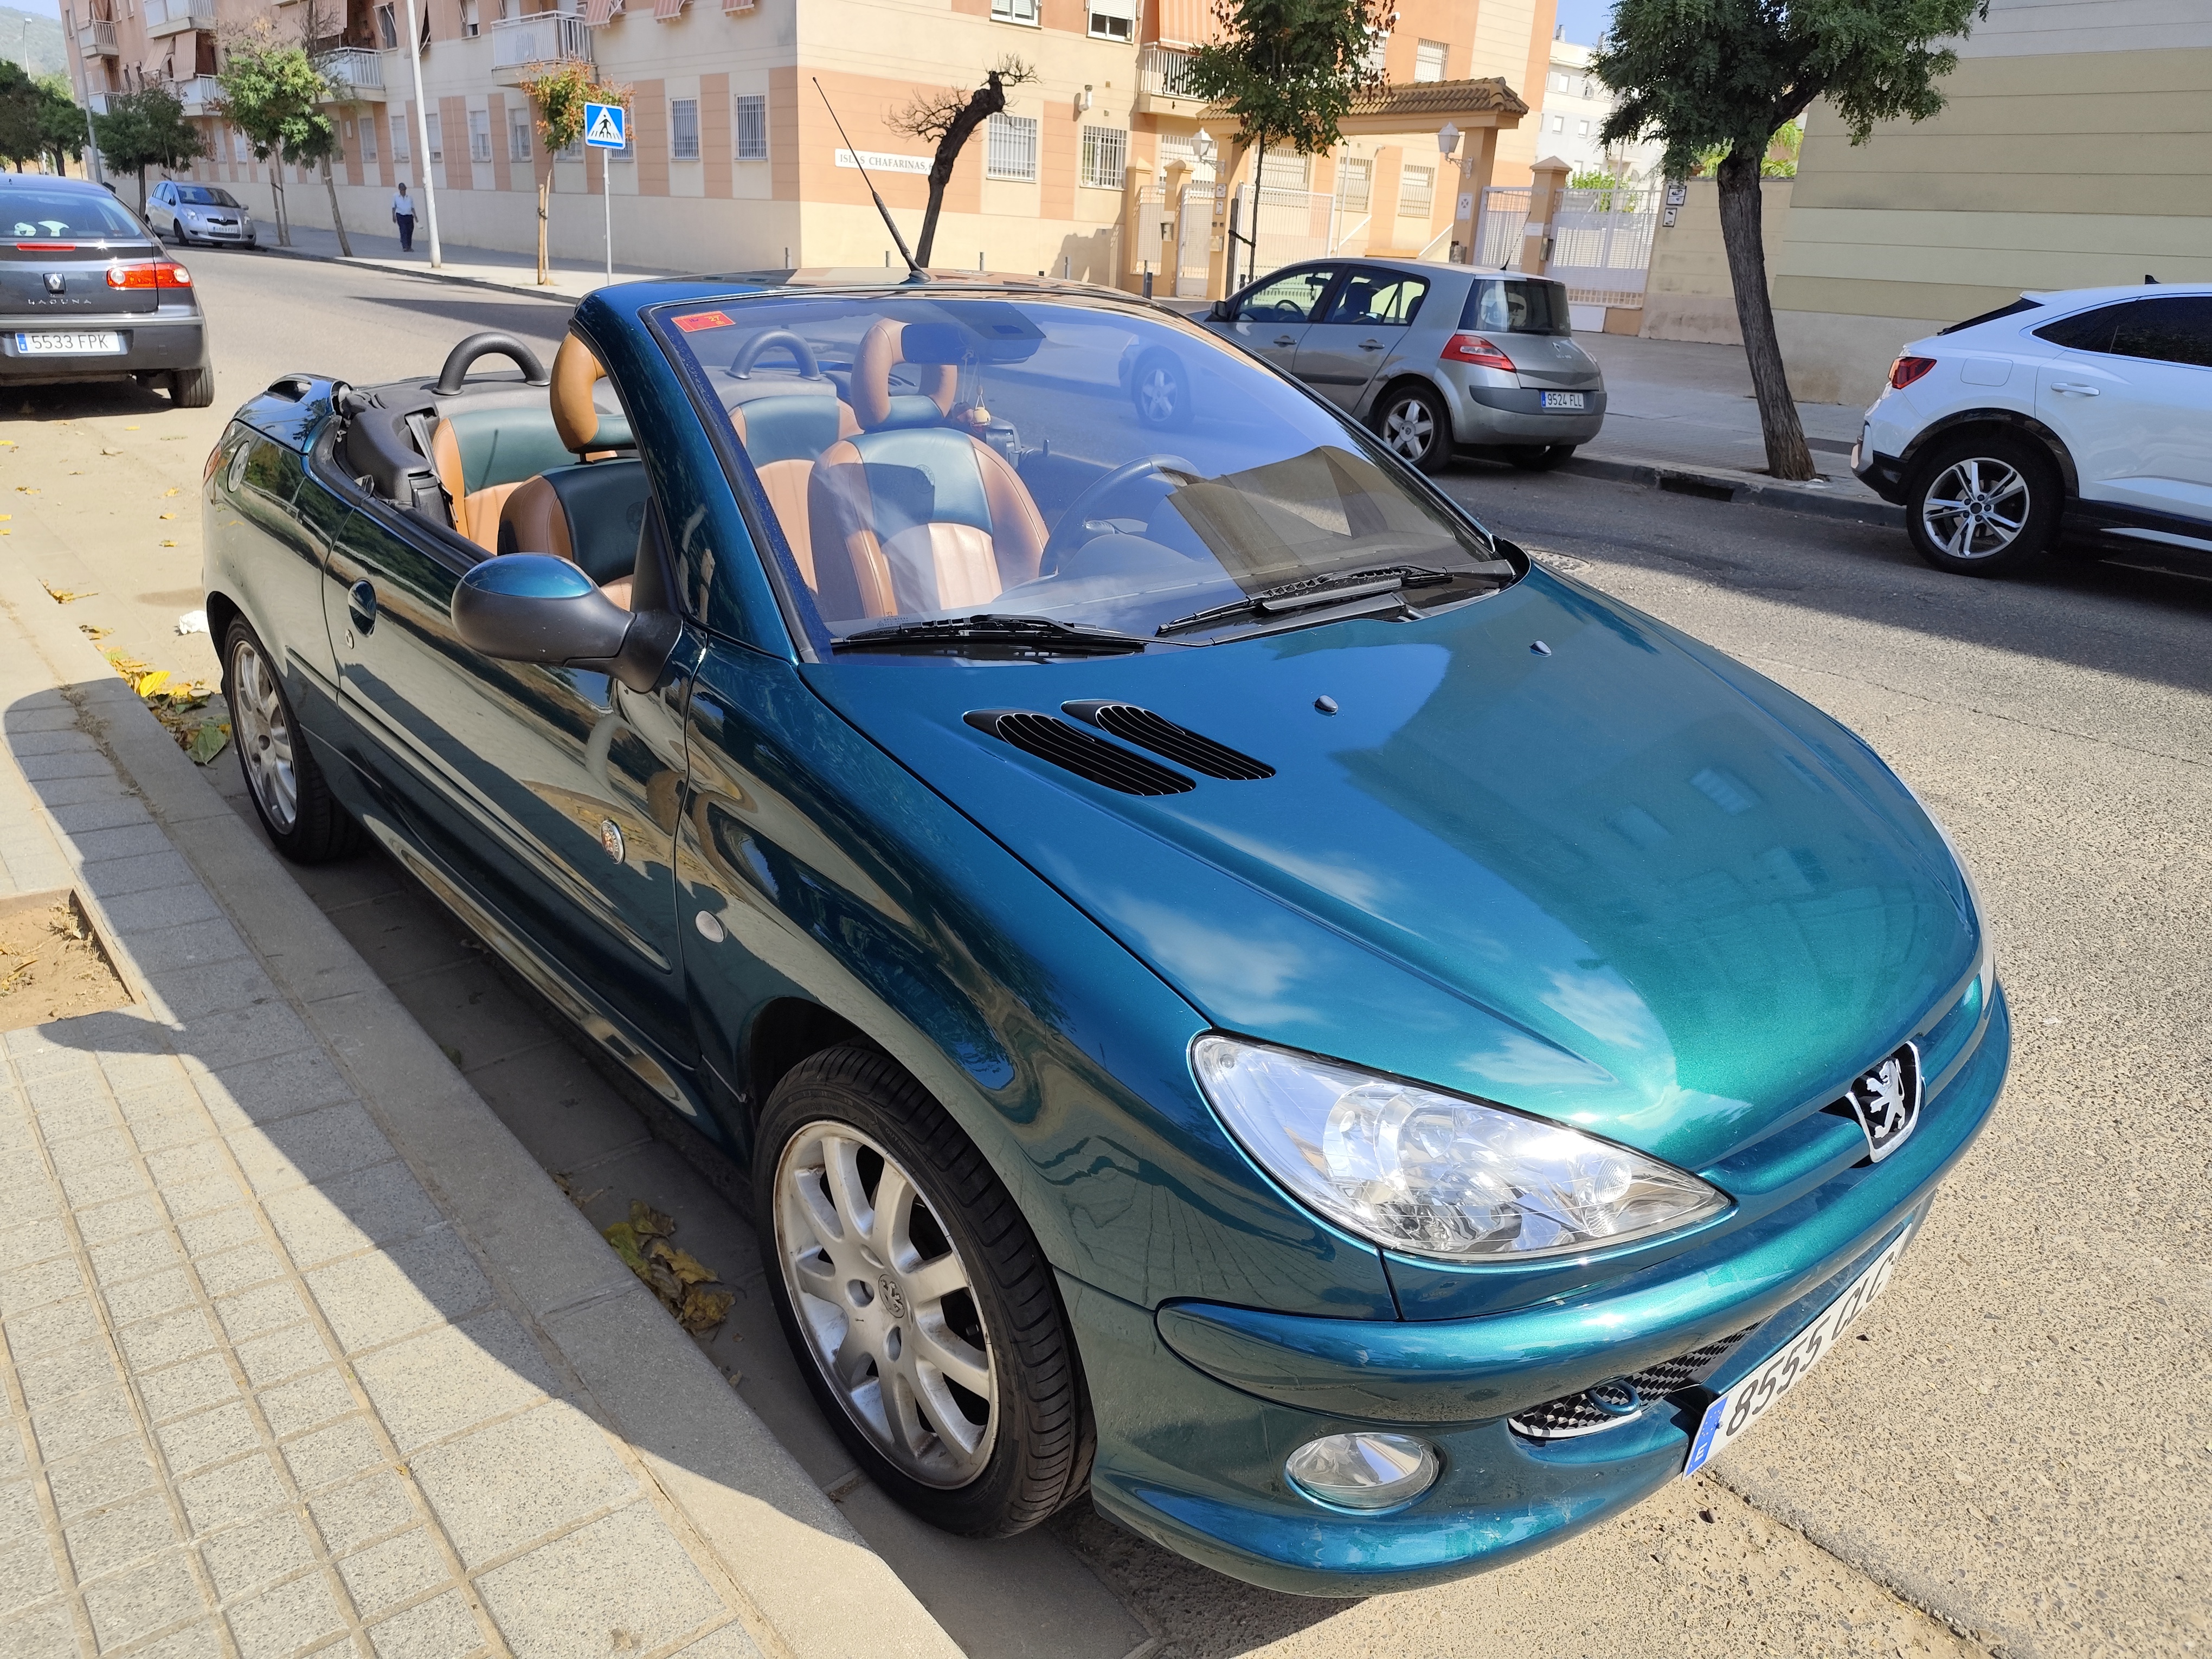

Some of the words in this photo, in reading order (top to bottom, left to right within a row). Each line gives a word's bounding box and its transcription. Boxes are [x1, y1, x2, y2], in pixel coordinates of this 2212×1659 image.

[840, 154, 865, 164] ISLS
[869, 157, 927, 171] CHAFARINAS,
[31, 335, 74, 349] 5533
[78, 334, 108, 349] FPK
[1547, 393, 1567, 406] 9524
[1570, 394, 1582, 407] FLL
[885, 1127, 913, 1158] OUTSIDE
[1726, 1315, 1831, 1437] 8555
[1831, 1251, 1895, 1341] CLC
